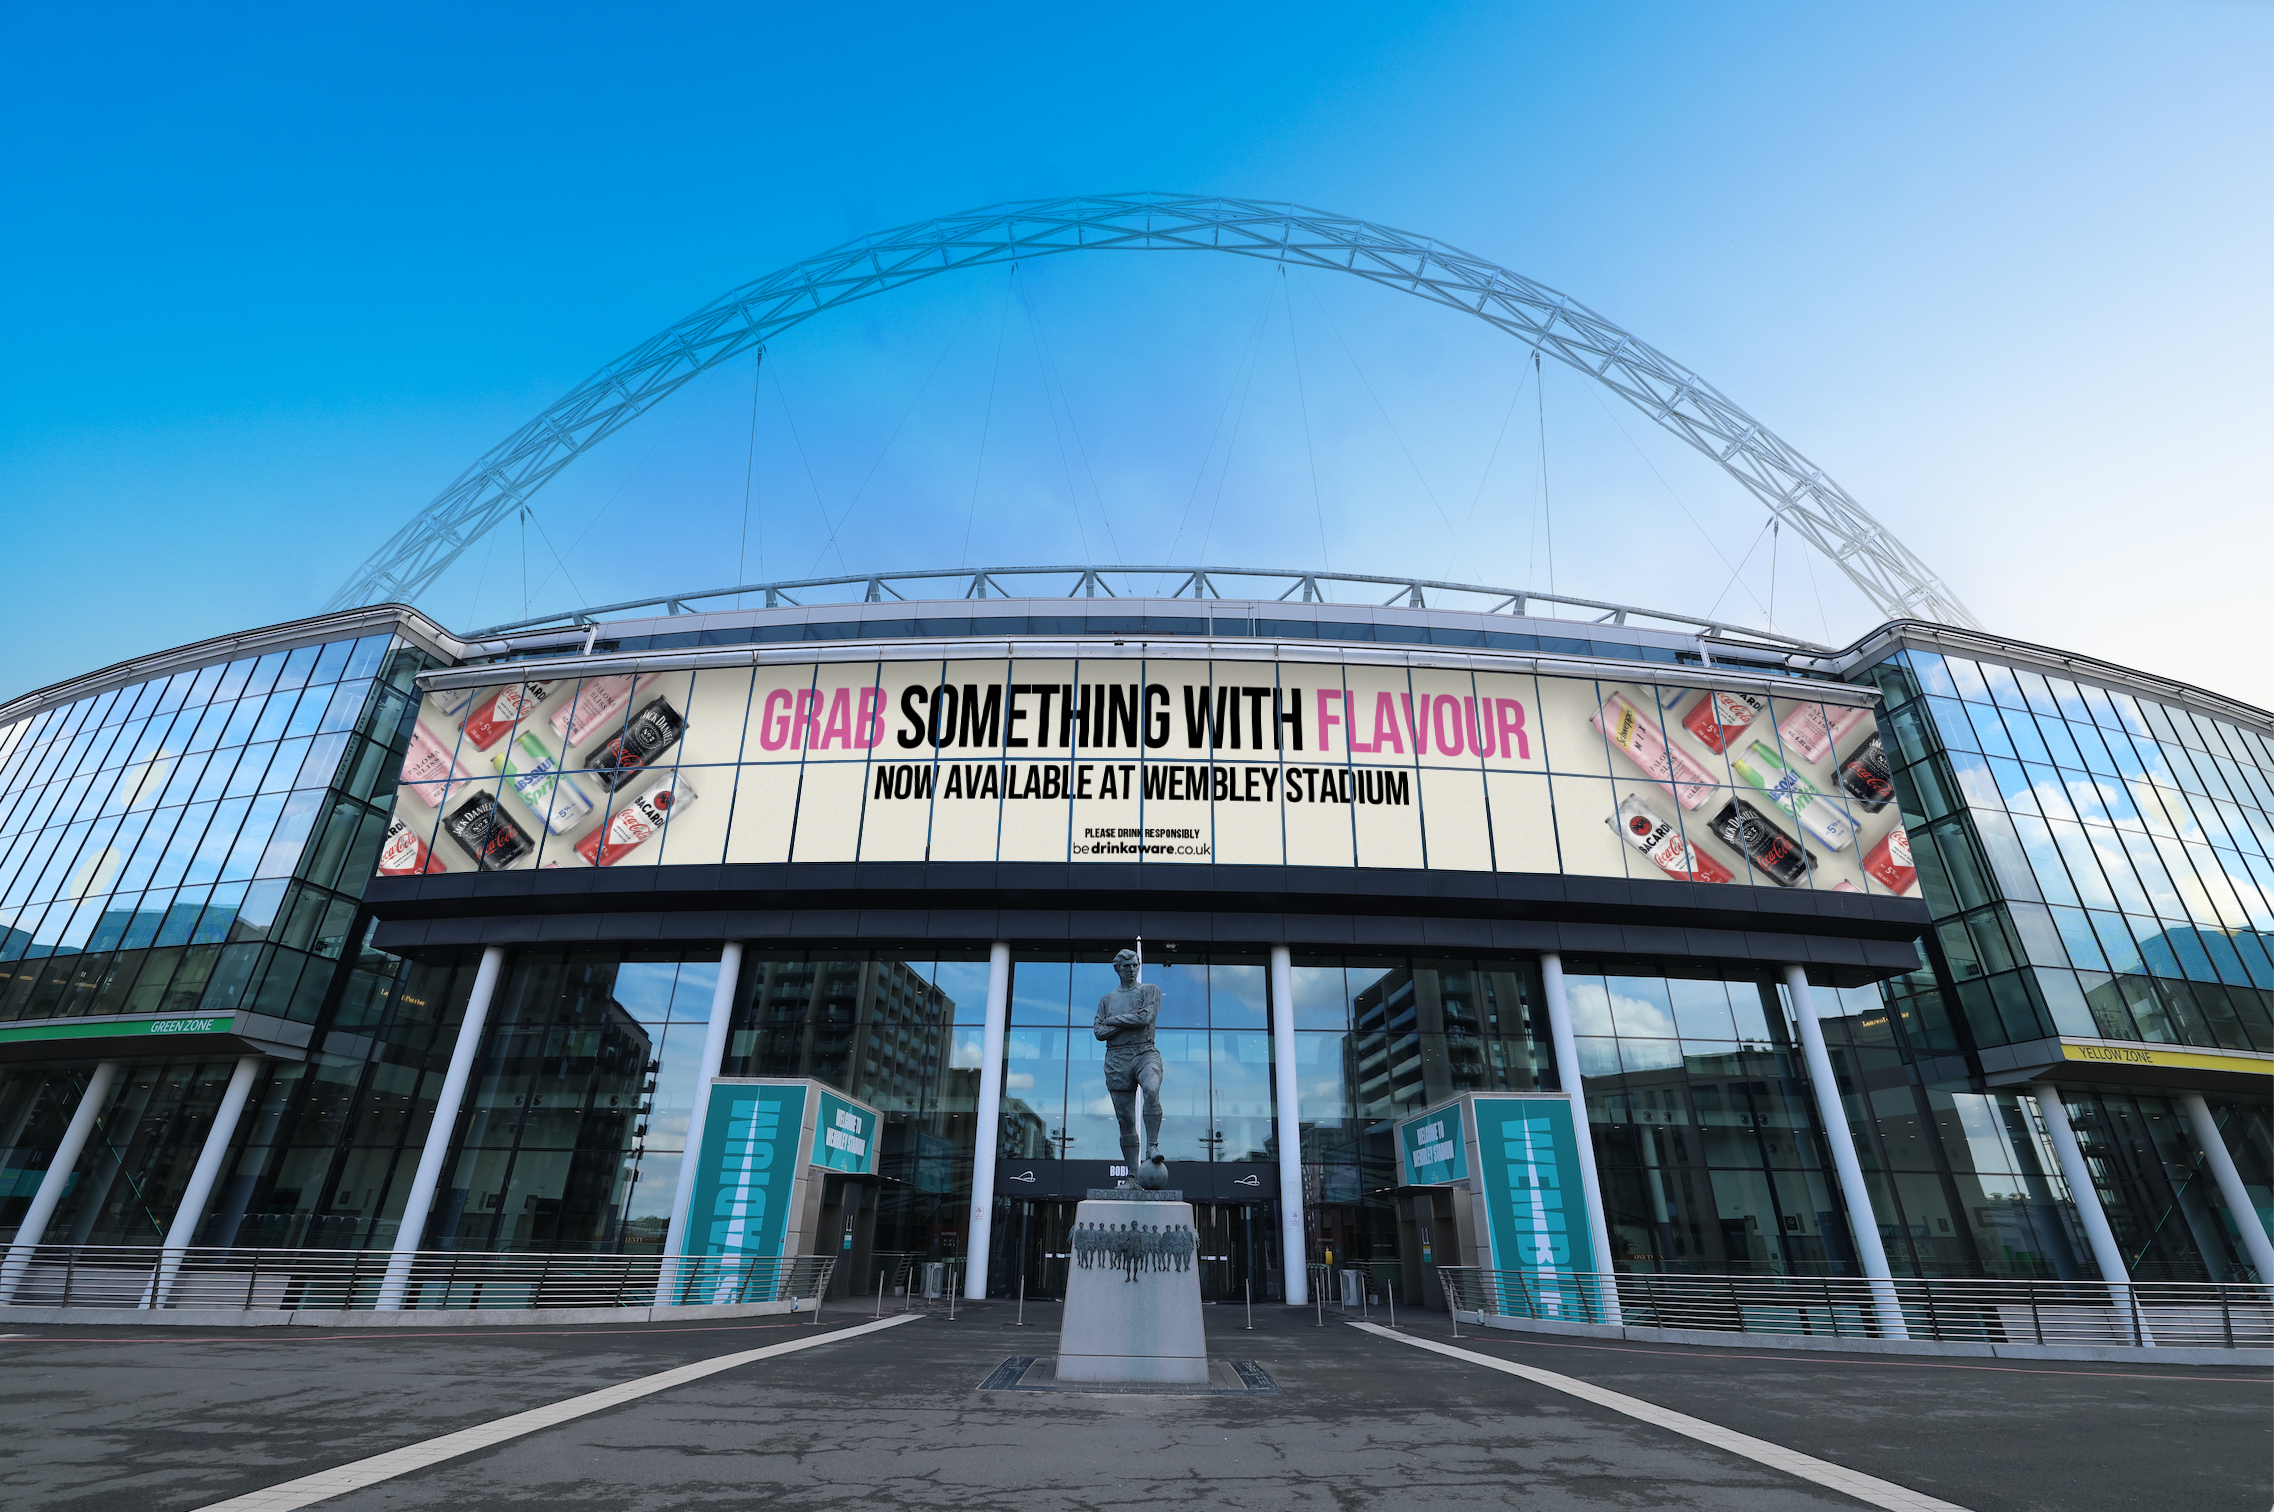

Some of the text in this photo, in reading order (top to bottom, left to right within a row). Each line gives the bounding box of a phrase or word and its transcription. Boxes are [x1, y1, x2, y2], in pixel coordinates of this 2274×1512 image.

[589, 692, 607, 711] BLISS
[593, 682, 617, 708] PALOMA
[641, 709, 658, 722] JACK
[760, 684, 1531, 760] GRAB SOMETHING WITH FLAVOUR
[1617, 708, 1635, 747] Schweppes
[1808, 704, 1840, 732] PALOMA
[1634, 724, 1647, 751] MIX
[407, 749, 441, 775] PALOMA
[416, 757, 440, 777] BLISS
[1650, 748, 1675, 772] PALOMA
[1660, 755, 1678, 775] BLISS
[514, 756, 556, 793] ABSOLUT
[874, 765, 1410, 805] NOW AVAILABLE AT WEMBLEY STADIUM
[1767, 769, 1802, 803] ABSOLUT
[1847, 761, 1895, 797] Coca-Cola
[525, 773, 566, 806] Sprite
[1784, 784, 1819, 820] Sprite
[453, 818, 468, 837] JACK
[617, 808, 653, 841] Coca-Cola
[1085, 828, 1200, 839] PLEASE DRINK RESPONSIBLY
[1723, 825, 1736, 844] JACK
[476, 822, 519, 860] Coca-Cola
[1654, 832, 1689, 868] Coca-Cola
[1757, 834, 1793, 871] Coca-Cola
[151, 1019, 214, 1032] GREEN ZONE
[2079, 1047, 2153, 1063] YELLOW ZONE
[856, 1116, 862, 1135] TO
[1437, 1120, 1445, 1139] TO
[700, 1100, 782, 1304] STADIUM
[1093, 1189, 1176, 1199] BOBBY MOORE
